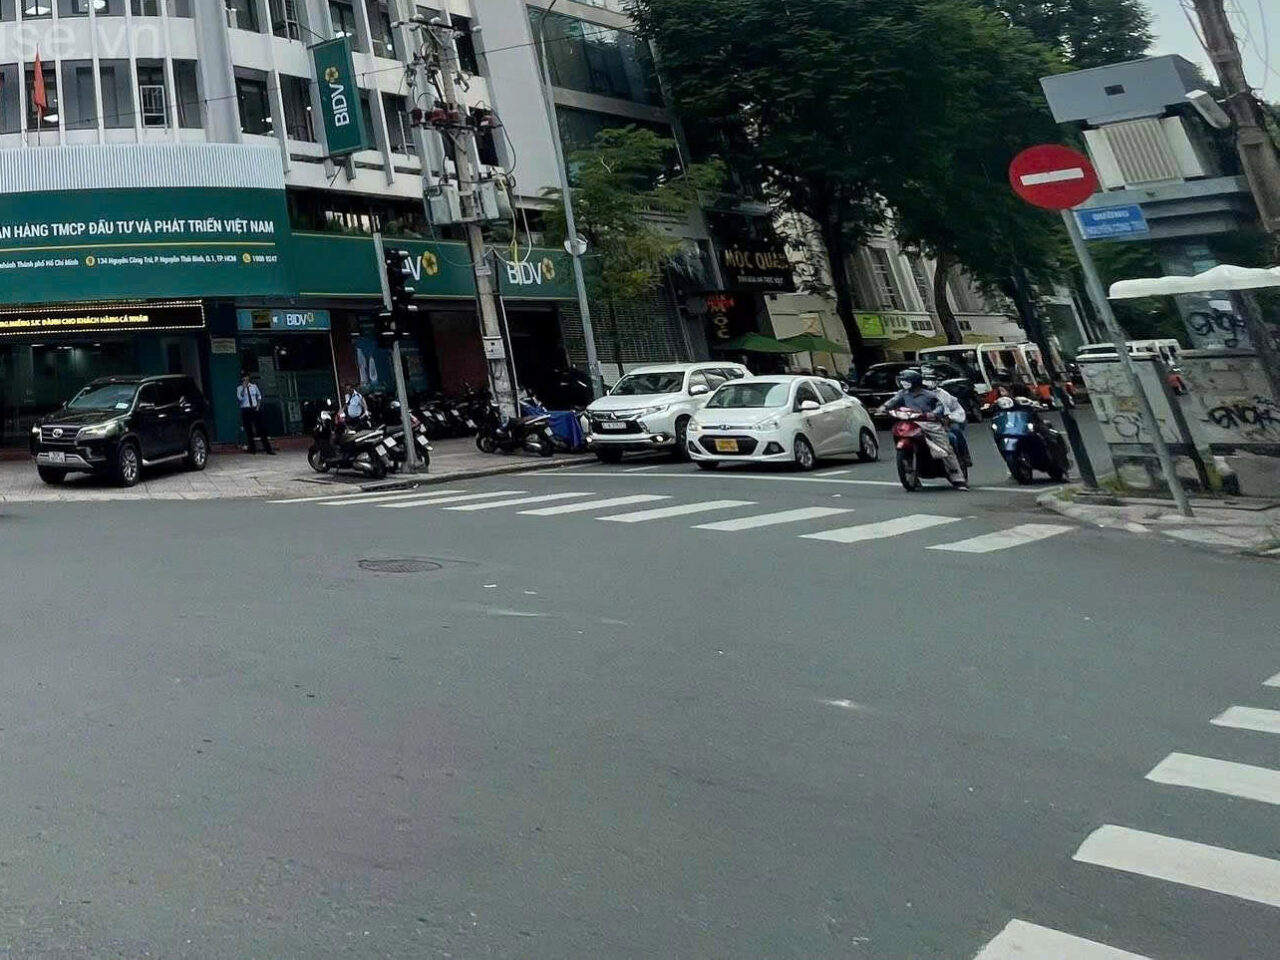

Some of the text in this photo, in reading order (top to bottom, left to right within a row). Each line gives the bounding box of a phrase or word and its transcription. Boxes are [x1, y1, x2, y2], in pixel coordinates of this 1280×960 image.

[329, 83, 350, 127] BIDV
[14, 223, 49, 238] HÀNG
[51, 222, 85, 236] TMCP
[88, 220, 113, 235] ĐẦU
[116, 220, 134, 234] TƯ
[136, 218, 152, 233] VÀ
[155, 217, 185, 233] PHÁT
[188, 217, 221, 233] TRIỂN
[224, 217, 248, 234] VIỆT
[250, 220, 274, 233] NAM
[507, 262, 542, 285] BIDV
[287, 313, 307, 326] BIDV
